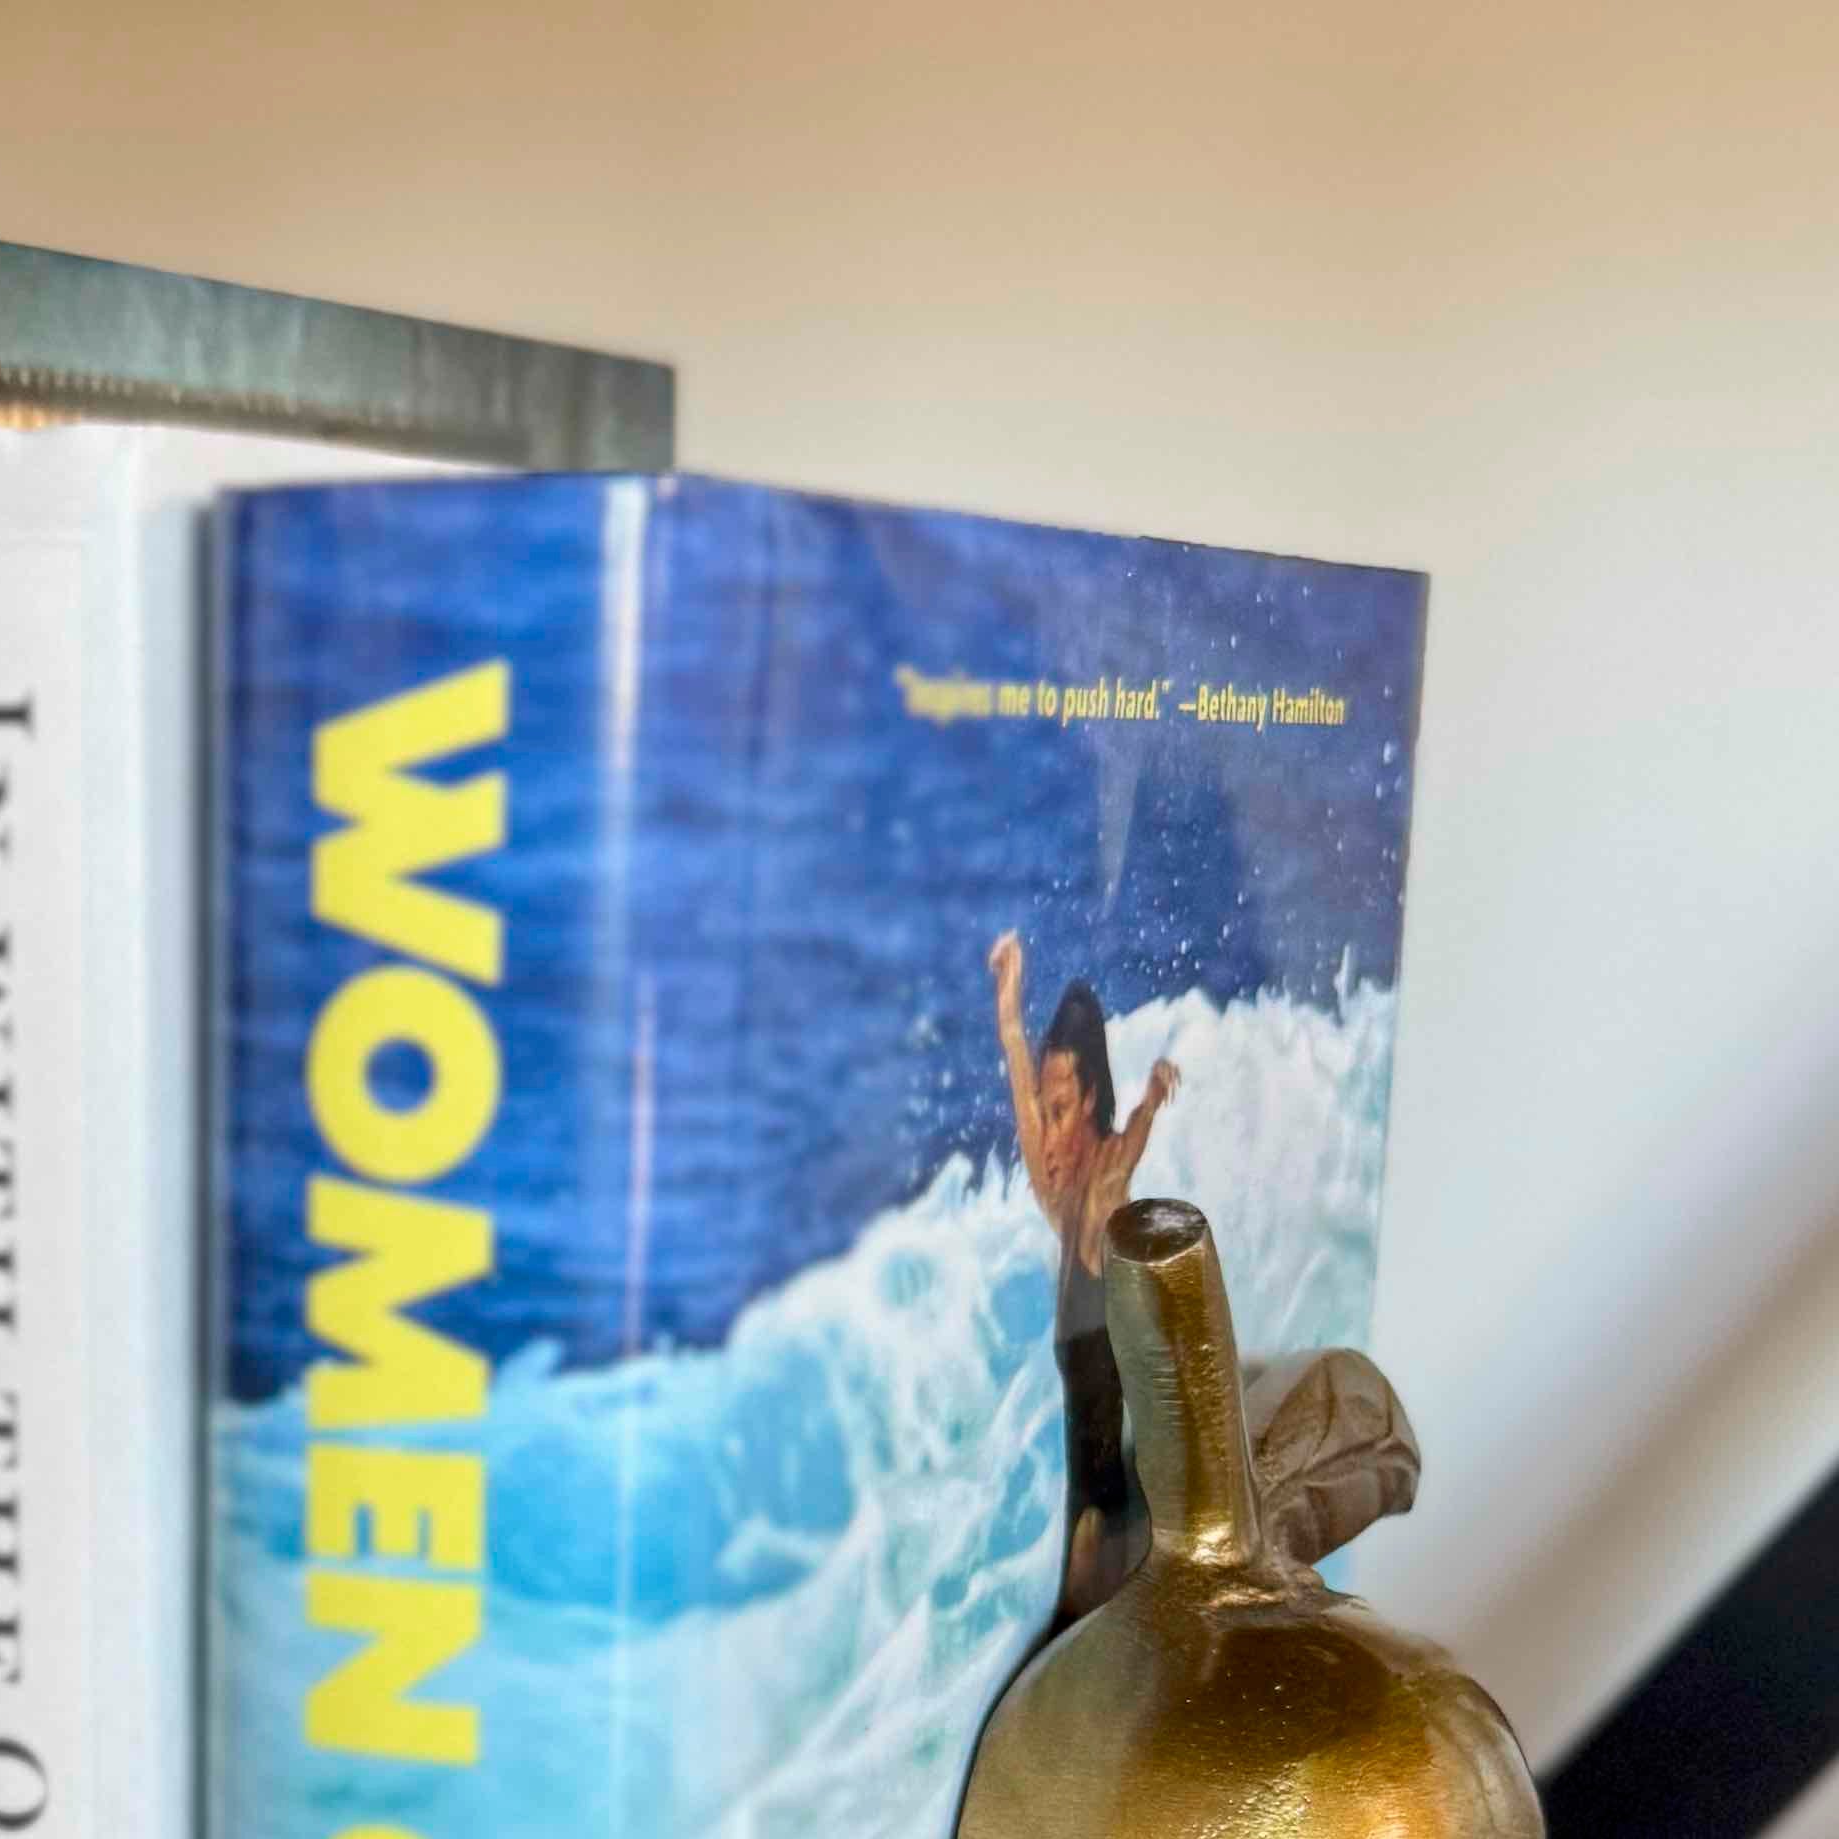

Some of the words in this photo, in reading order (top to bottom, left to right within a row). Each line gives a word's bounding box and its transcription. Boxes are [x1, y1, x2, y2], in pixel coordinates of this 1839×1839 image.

[1037, 679, 1057, 718] to
[1062, 677, 1108, 727] push
[1272, 686, 1346, 725] Hamilton
[303, 656, 511, 1767] WOMEN
